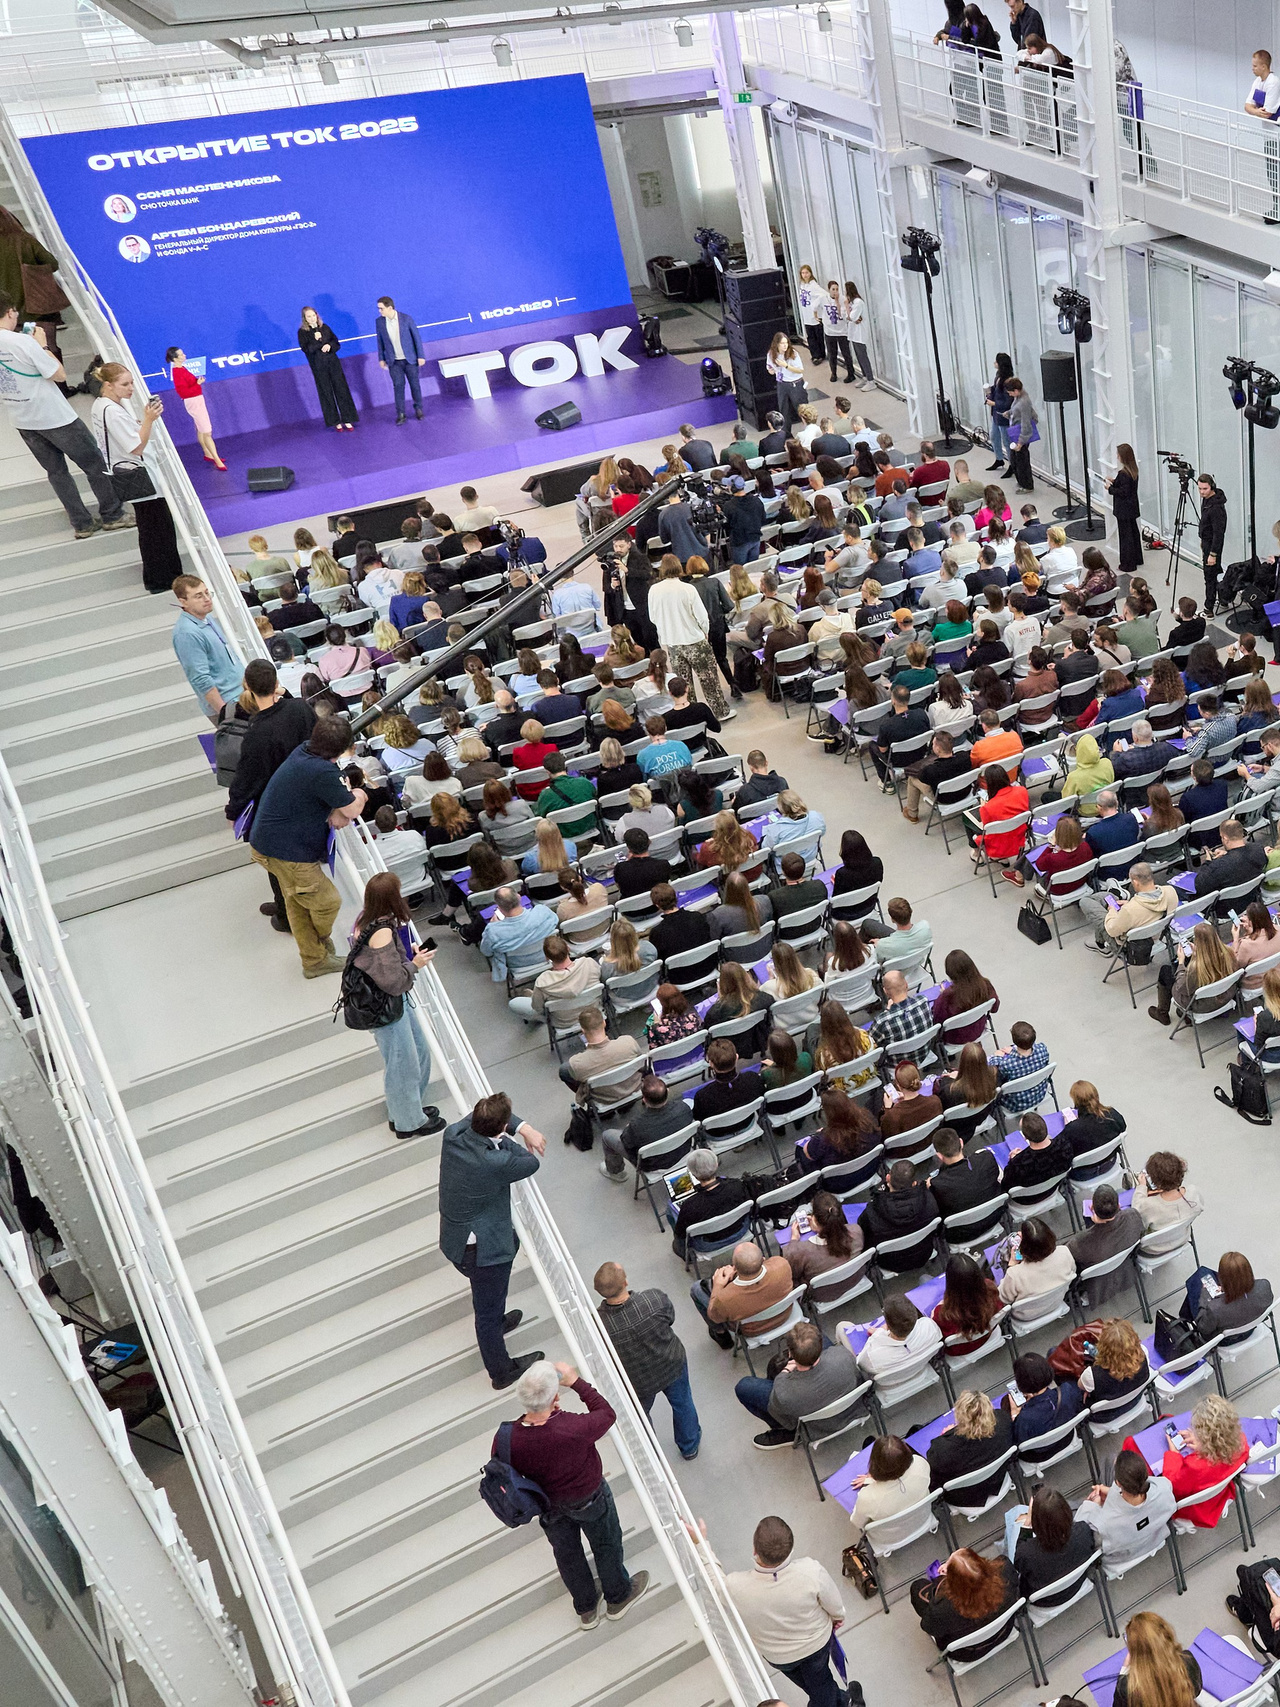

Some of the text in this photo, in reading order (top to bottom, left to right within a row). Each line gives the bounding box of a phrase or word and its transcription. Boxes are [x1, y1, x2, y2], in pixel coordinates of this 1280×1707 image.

[88, 116, 419, 171] ОТКРЫТИЕ ТОК 2025
[136, 174, 281, 201] СОНЯ МАСЛЕННИКОВА
[157, 199, 181, 208] ТОЧКА
[180, 197, 200, 205] БАНК
[151, 211, 301, 241] АРТЕМ БОНДАРЕВСКИЙ
[154, 236, 204, 250] ГЕНЕРАЛЬНЫЙ
[204, 232, 239, 244] ДИРЕКТОР
[239, 228, 260, 239] ДОМА
[259, 225, 292, 236] КУЛЬТУРЫ
[162, 247, 189, 257] ФОНДА
[211, 351, 260, 369] ТОК
[438, 325, 640, 400] ТОК
[867, 610, 893, 624] GALLER
[656, 751, 678, 766] POST
